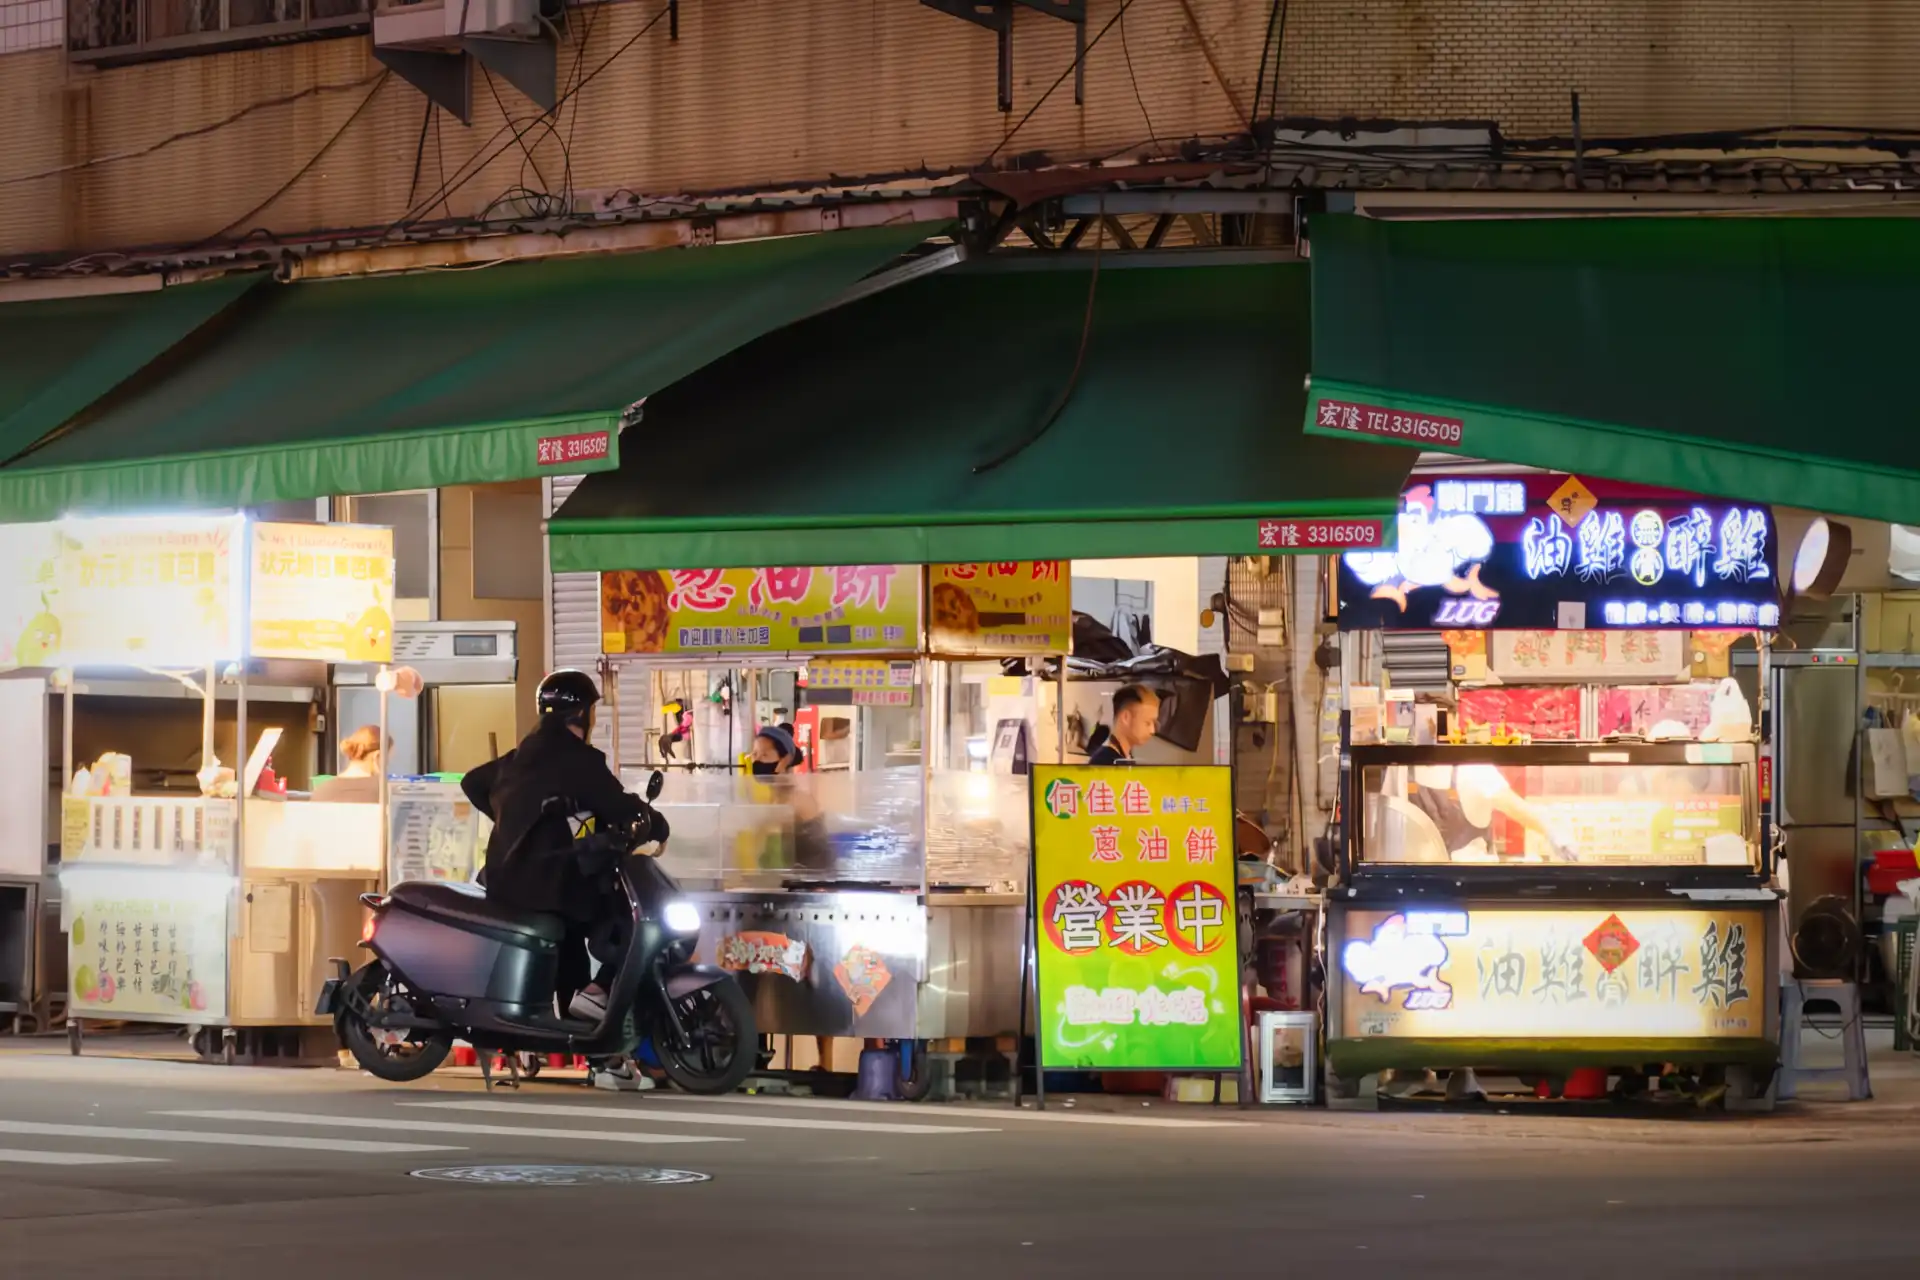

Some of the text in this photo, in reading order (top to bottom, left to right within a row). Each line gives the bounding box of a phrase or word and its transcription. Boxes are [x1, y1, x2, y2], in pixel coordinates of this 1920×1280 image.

[1367, 411, 1390, 431] TEL
[1391, 415, 1461, 442] 3316509
[567, 436, 608, 458] 3316509
[1259, 522, 1375, 546] 宏隆 3316509
[1523, 510, 1628, 583] 油雞
[1666, 507, 1771, 587] 醉雞
[1435, 599, 1501, 623] LUG
[1047, 779, 1151, 816] 何佳佳
[1090, 826, 1218, 863] 蔥油餅
[1053, 884, 1224, 952] 營業中
[1477, 928, 1588, 1004] 油雞
[1637, 920, 1749, 1008] 醉雞
